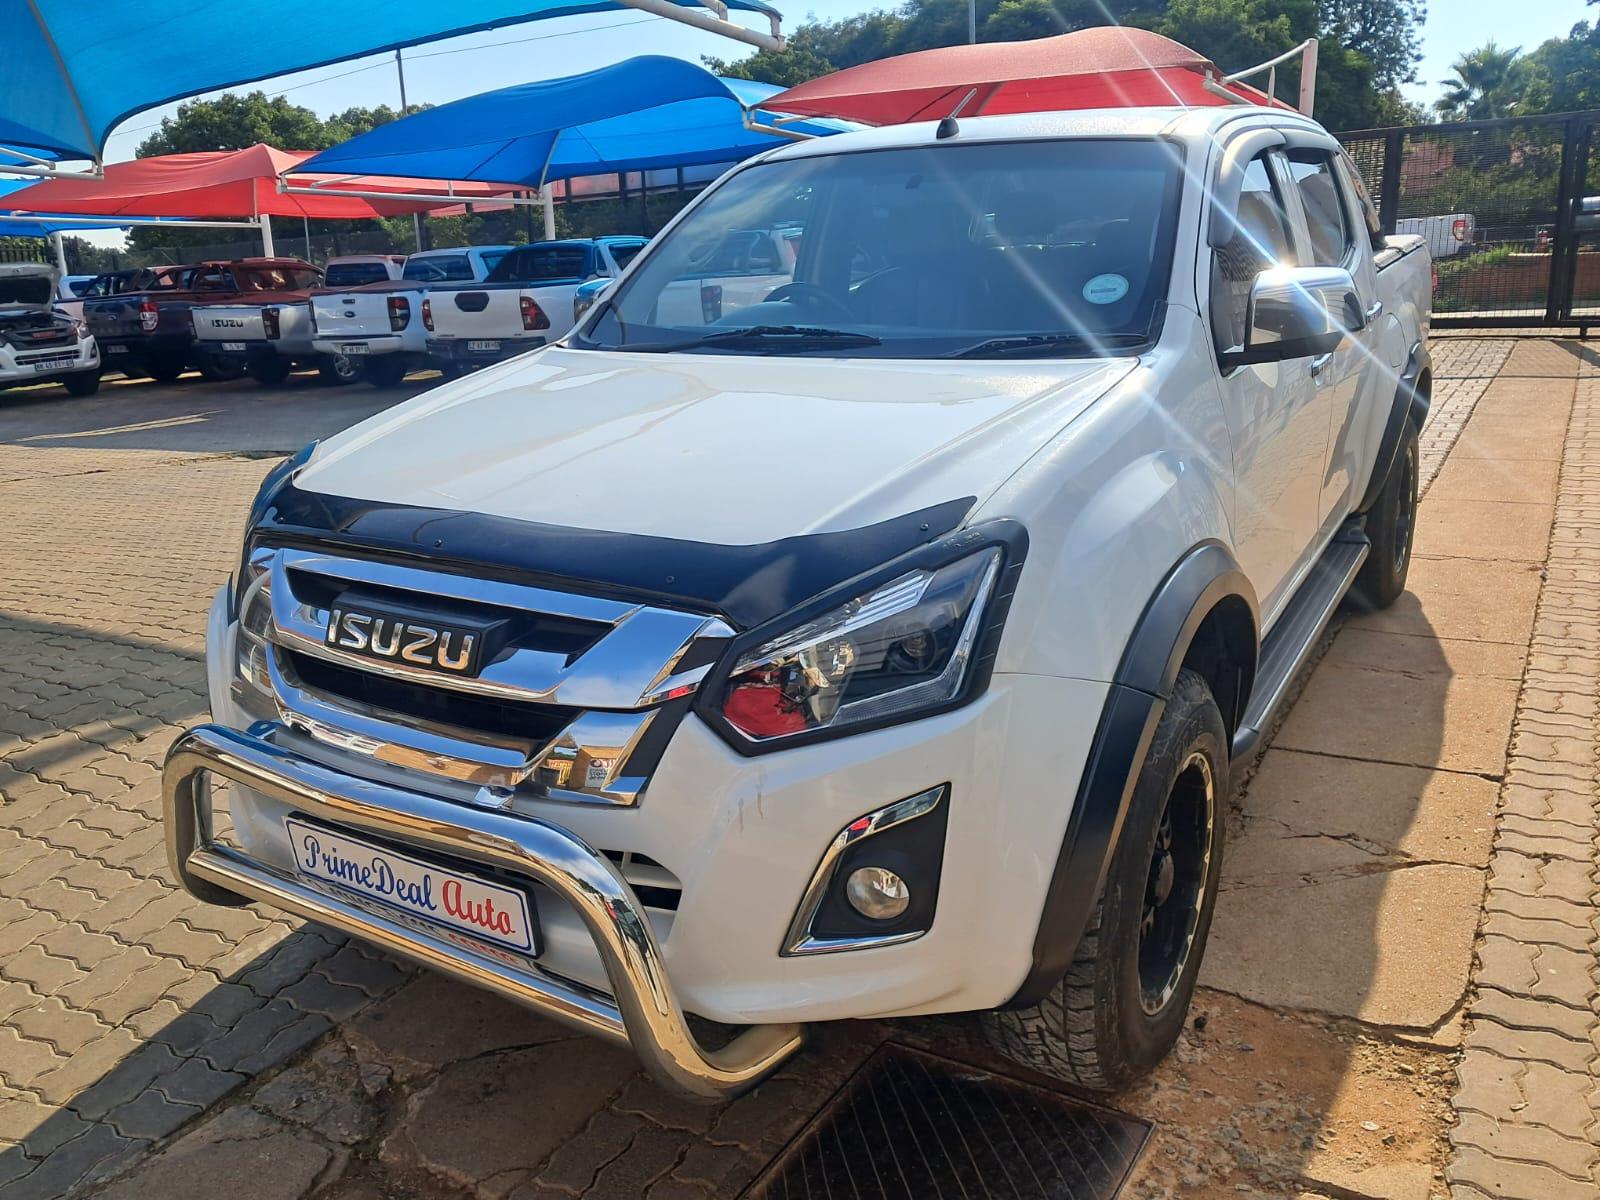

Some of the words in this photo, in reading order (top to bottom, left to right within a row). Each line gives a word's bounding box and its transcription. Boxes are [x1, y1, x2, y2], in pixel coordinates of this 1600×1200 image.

[211, 319, 244, 328] ISUZU
[327, 609, 475, 671] ISUZU
[303, 835, 438, 911] PrimeDeal
[442, 879, 516, 936] Auto
